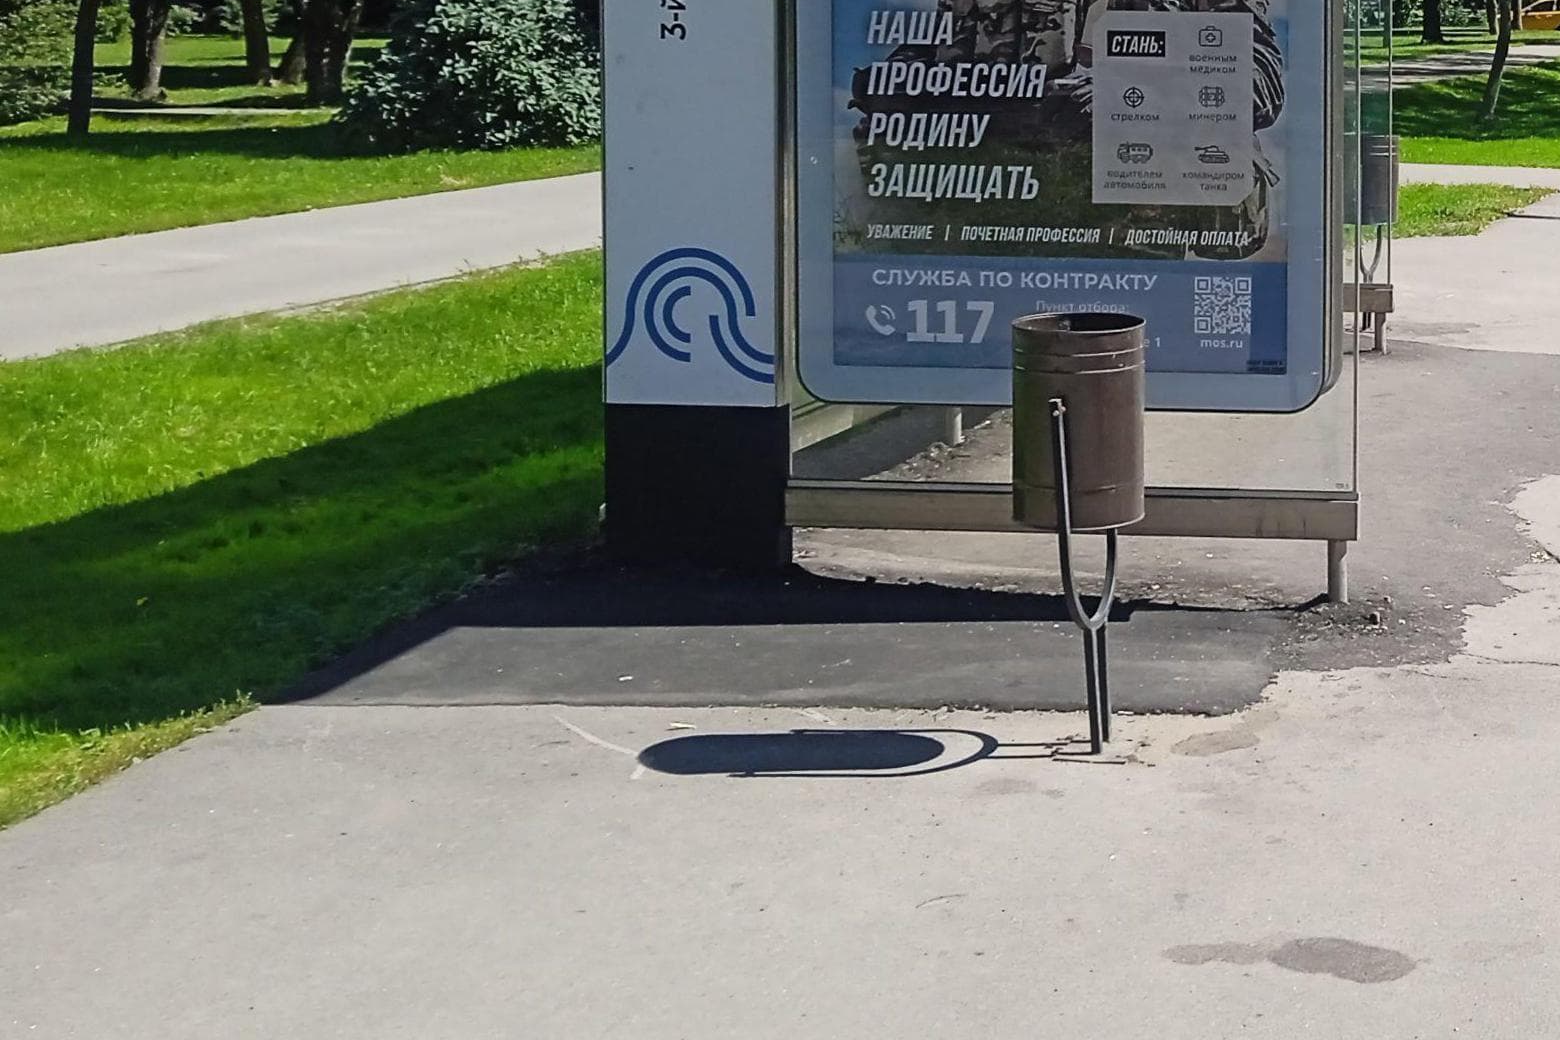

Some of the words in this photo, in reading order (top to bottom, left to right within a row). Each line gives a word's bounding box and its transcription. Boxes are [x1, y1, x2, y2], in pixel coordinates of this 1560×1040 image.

[867, 11, 953, 45] НАША
[1112, 35, 1164, 54] СТАНЬ:
[1190, 65, 1236, 74] медиком
[867, 61, 1047, 98] ПРОФЕССИЯ
[1111, 113, 1160, 122] стрелком
[867, 112, 990, 151] РОДИНУ
[868, 163, 1039, 203] ЗАЩИЩАТЬ
[1183, 171, 1244, 181] командиром
[1104, 180, 1166, 190] автомобиля
[1201, 183, 1227, 191] танка
[867, 224, 934, 240] УВАЖЕНИЕ
[961, 226, 1024, 241] ПОЧЕТНАЯ
[1026, 227, 1100, 243] ПРОФЕССИЯ
[1124, 227, 1198, 246] ДОСТОЙНАЯ
[1200, 231, 1249, 246] ОПЛАТА
[872, 269, 972, 287] СЛУЖБА
[979, 271, 1013, 287] ПО
[1020, 272, 1158, 291] КОНТРАКТУ
[1036, 300, 1075, 312] Пункт
[1078, 301, 1129, 313] отбора:
[907, 300, 995, 344] 117
[1154, 337, 1161, 348] 1
[1200, 338, 1243, 349] mos.ru
